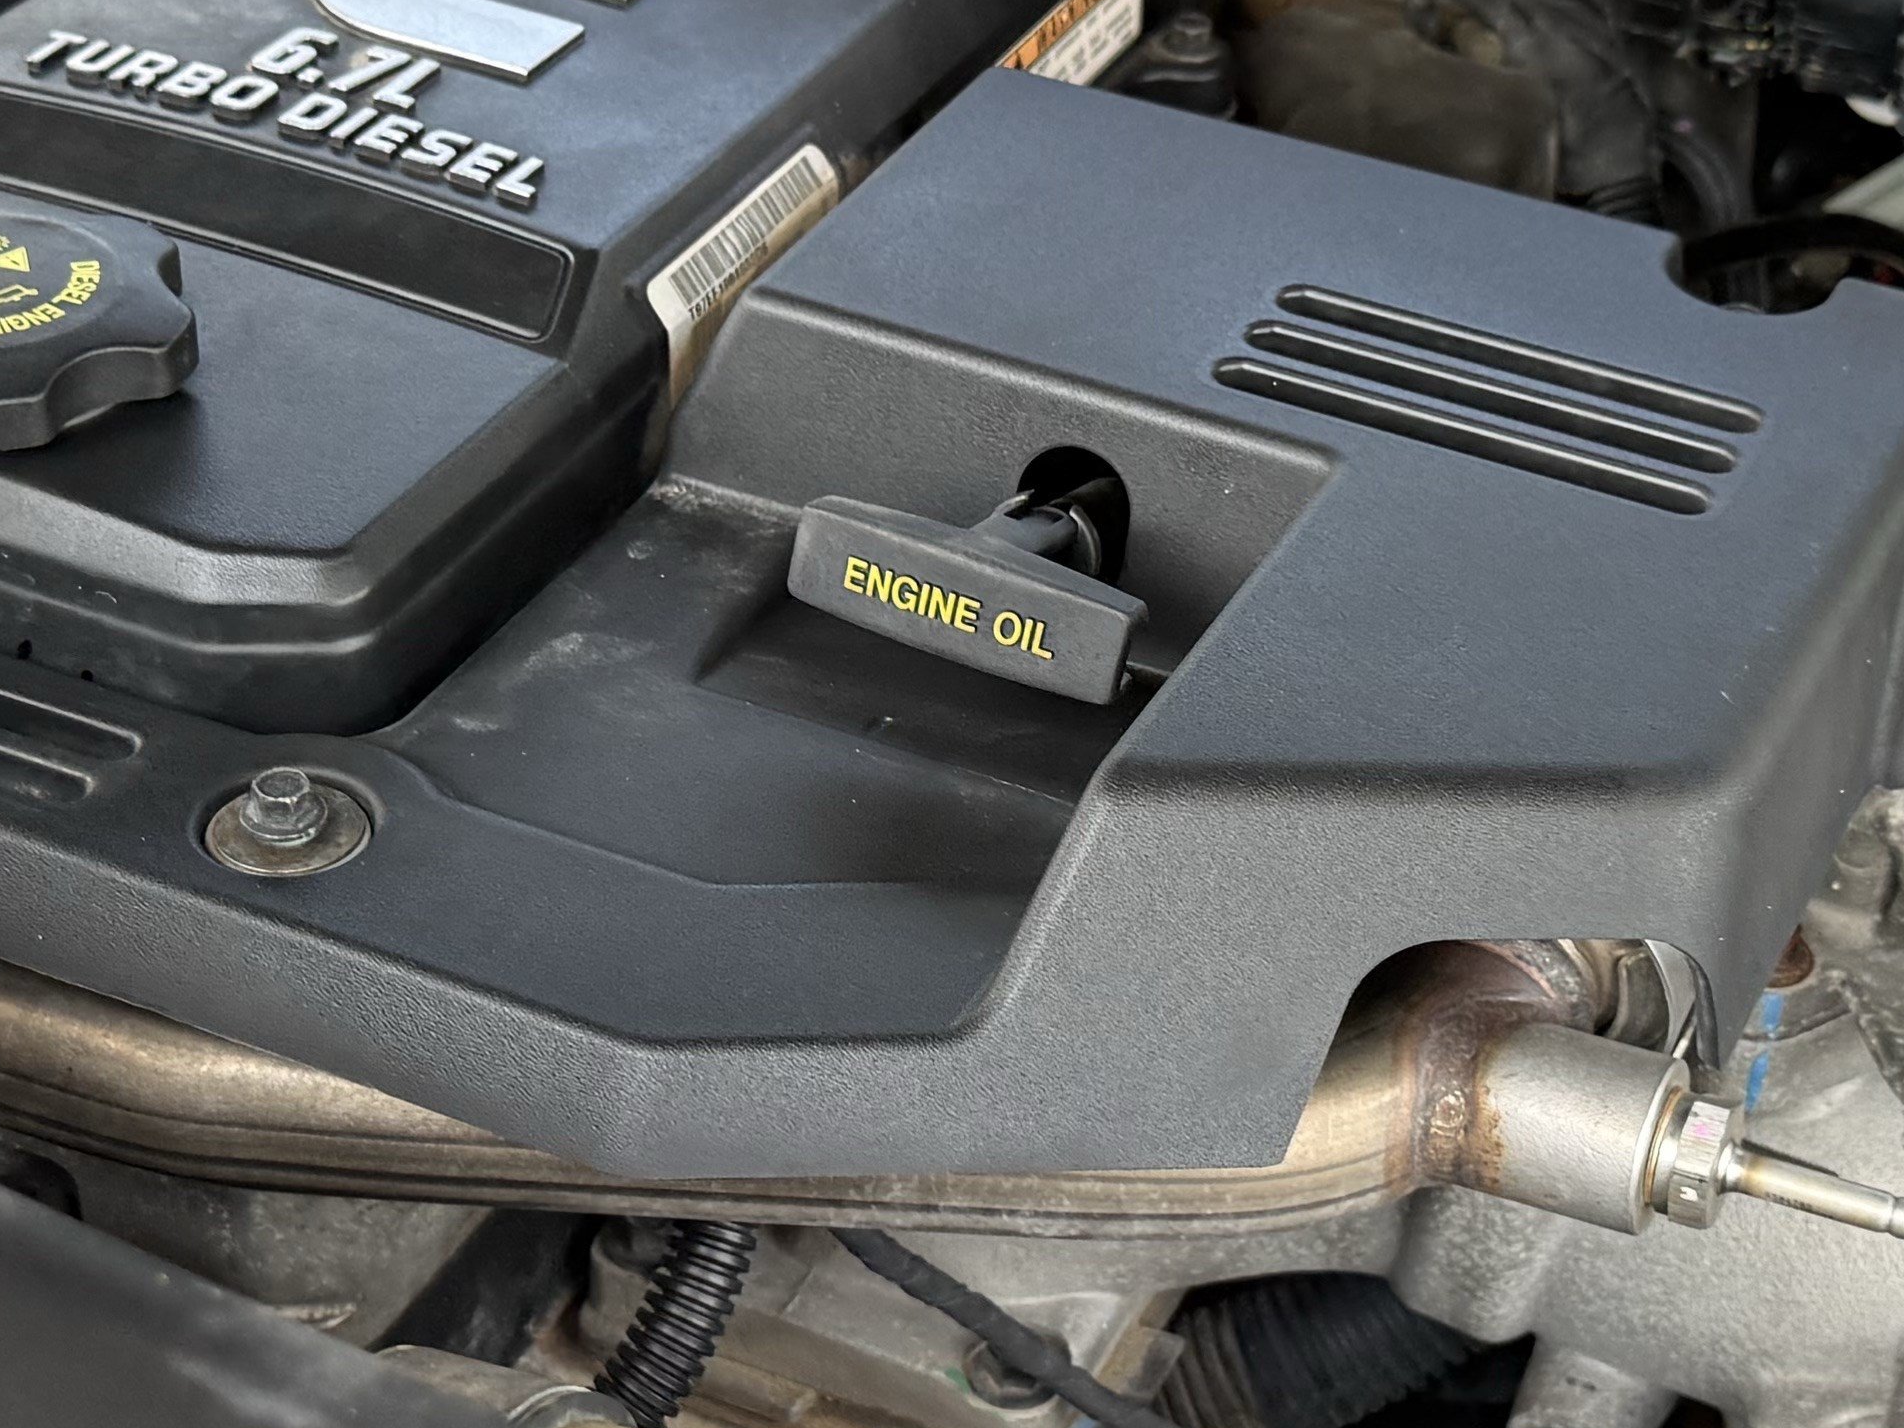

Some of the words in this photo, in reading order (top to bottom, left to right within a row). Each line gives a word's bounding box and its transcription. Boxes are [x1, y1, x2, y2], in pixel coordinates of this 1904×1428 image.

[24, 29, 279, 121] TURBO
[277, 89, 545, 205] DIESEL
[252, 26, 441, 112] 6.7L
[55, 260, 101, 306] DIESEL
[843, 555, 984, 634] ENGINE
[993, 609, 1055, 661] OIL
